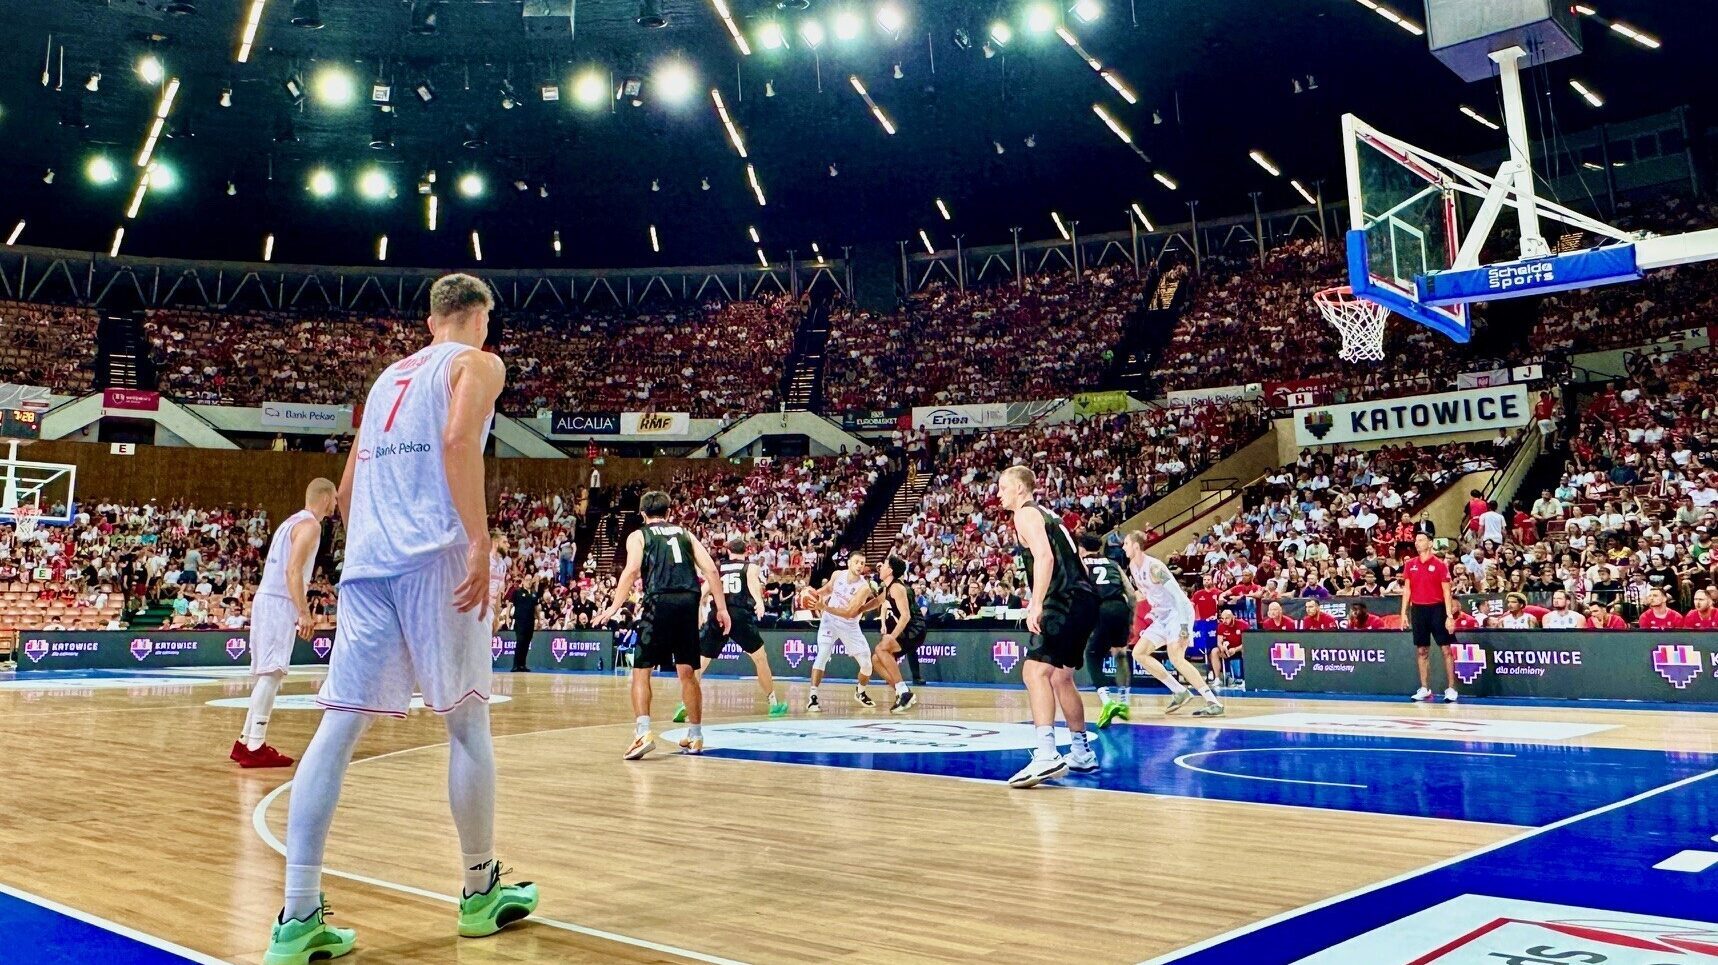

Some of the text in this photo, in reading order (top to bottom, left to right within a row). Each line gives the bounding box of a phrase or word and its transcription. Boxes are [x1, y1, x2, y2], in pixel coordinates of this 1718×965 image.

[1488, 272, 1555, 289] Sports
[1691, 329, 1701, 337] K
[1523, 366, 1532, 378] J
[384, 378, 413, 432] 7
[1296, 394, 1305, 404] H
[286, 410, 336, 421] Bank Pekao
[932, 415, 969, 425] Enea
[1350, 394, 1519, 434] KATOWICE
[119, 444, 127, 453] E
[376, 442, 431, 458] Bank Pekao
[667, 537, 683, 563] 1
[1093, 566, 1110, 585] 2
[720, 572, 742, 594] 15
[52, 643, 99, 651] KATOWICE
[155, 642, 198, 650] KATOWICE
[569, 641, 601, 651] KATOWICE
[916, 645, 957, 656] ATOWICE
[1311, 649, 1386, 662] KATOWICE
[1493, 650, 1582, 665] KATOWICE
[1496, 666, 1545, 678] dla odmiany
